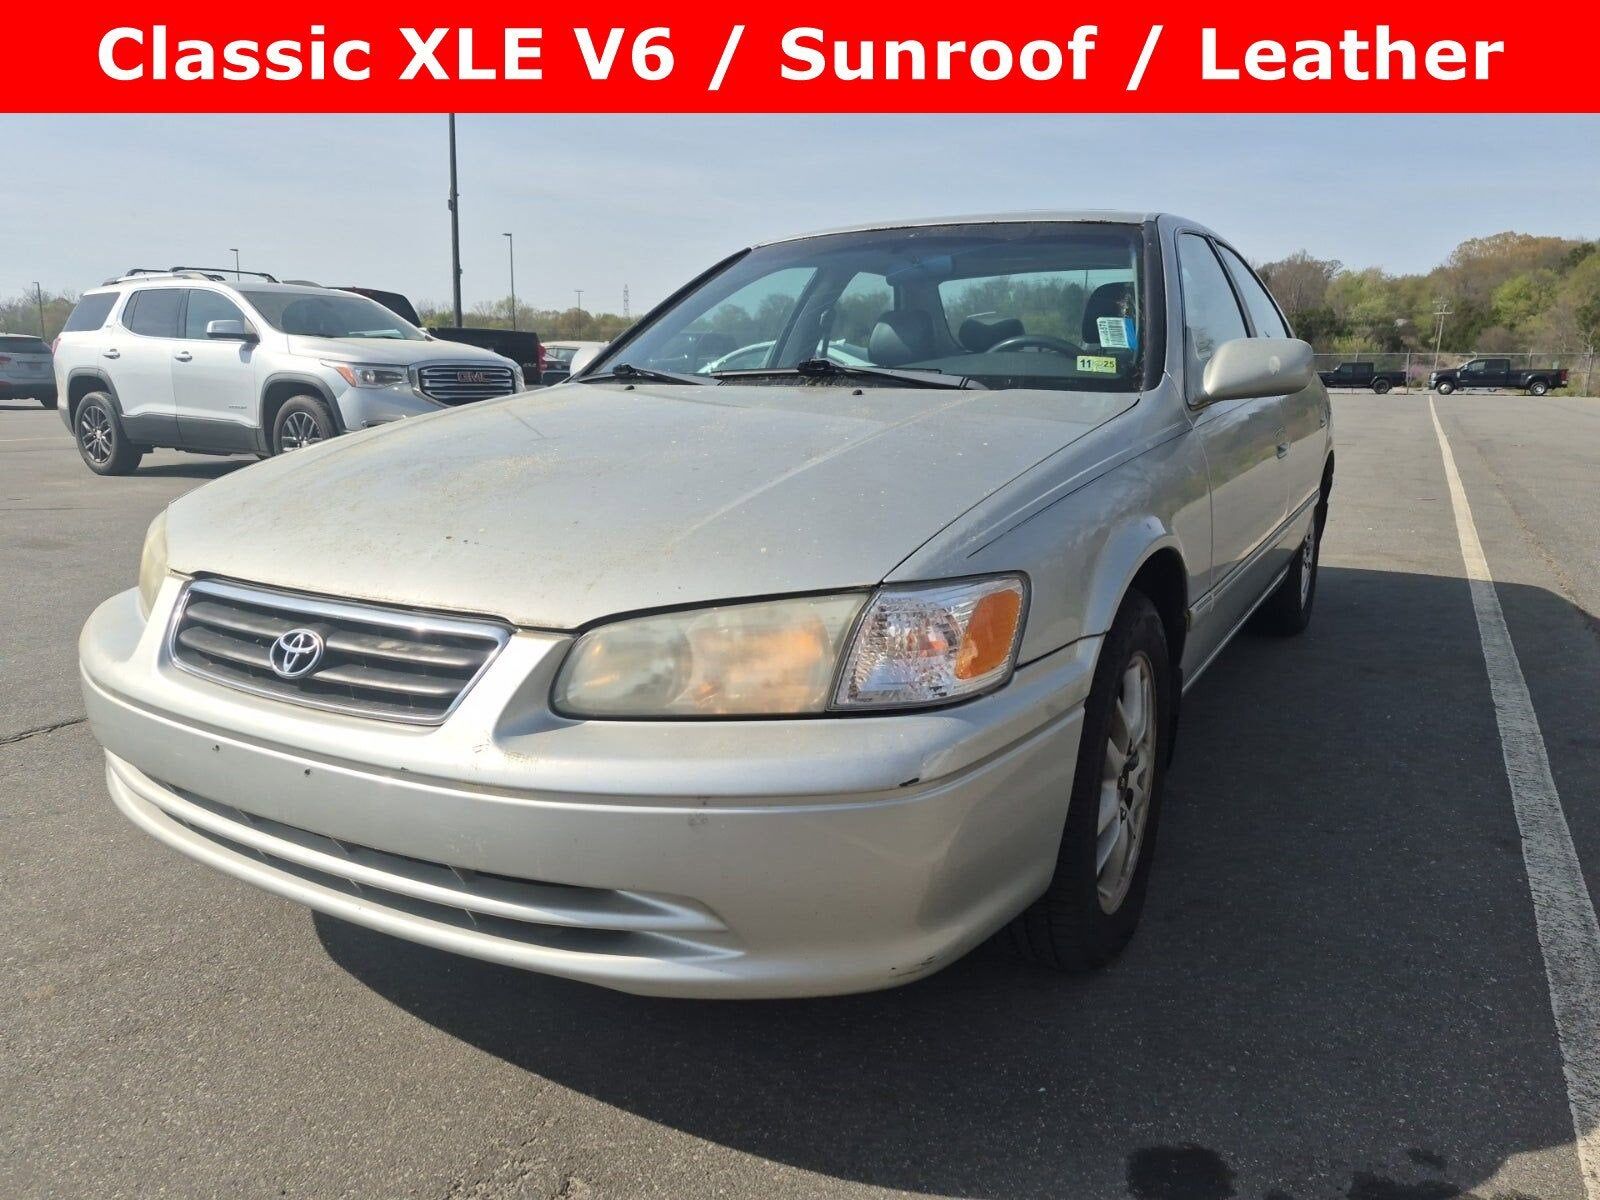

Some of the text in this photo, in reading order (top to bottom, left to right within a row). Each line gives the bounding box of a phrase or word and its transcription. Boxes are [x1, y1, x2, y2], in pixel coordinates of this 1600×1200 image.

[1080, 359, 1115, 368] 11 25
[457, 371, 490, 382] GMC
